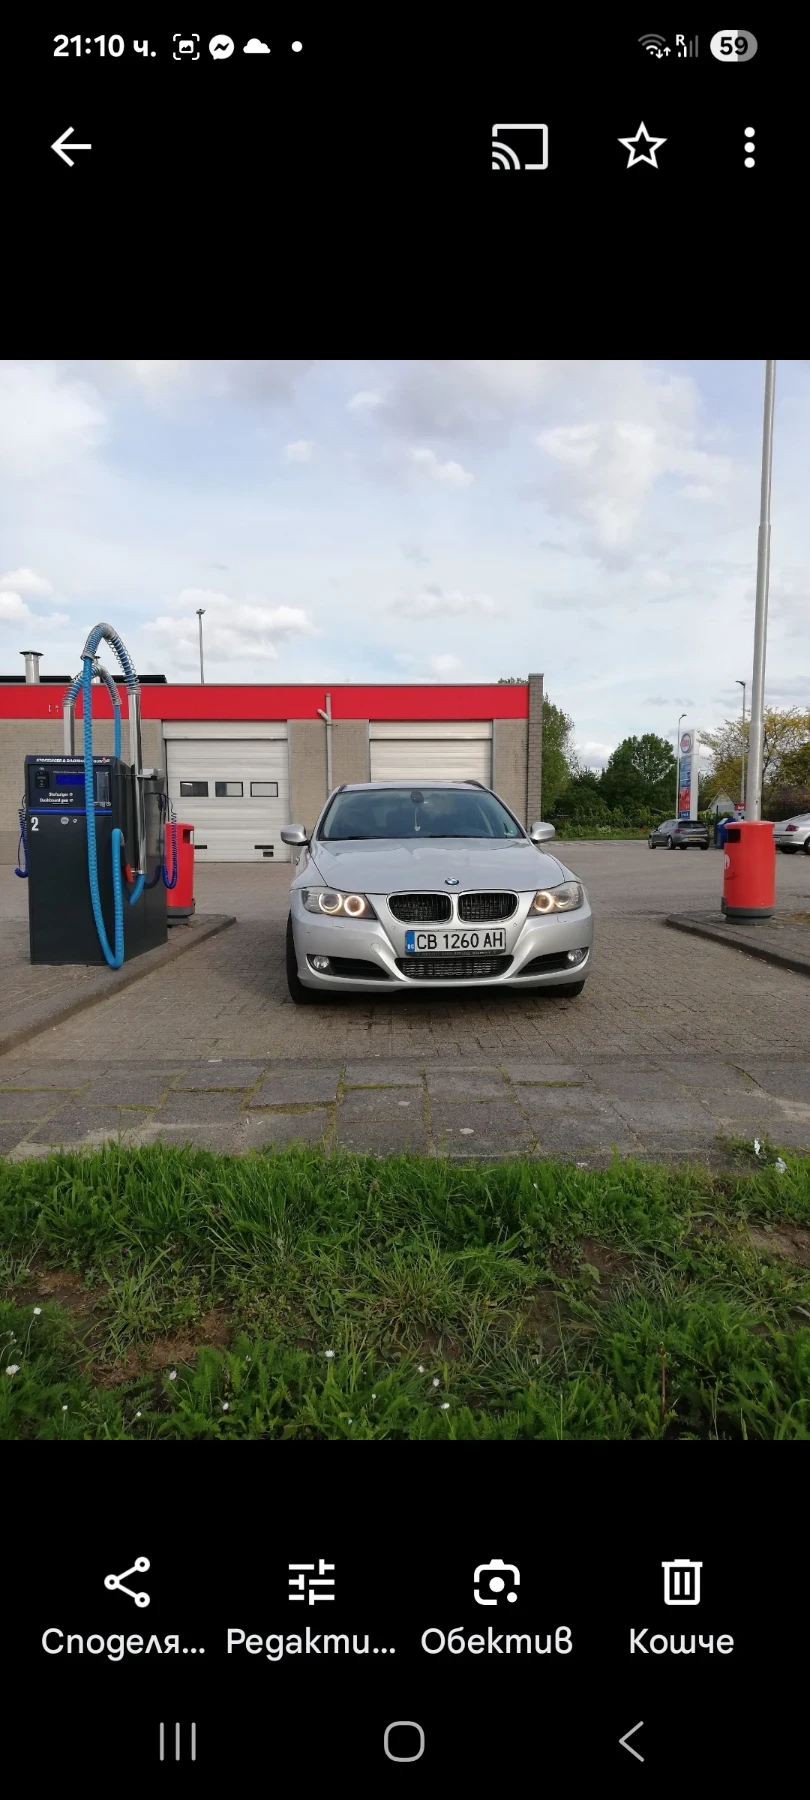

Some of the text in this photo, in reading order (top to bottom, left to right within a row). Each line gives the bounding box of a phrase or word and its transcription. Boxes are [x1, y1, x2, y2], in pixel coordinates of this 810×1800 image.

[30, 816, 39, 831] 2
[416, 931, 503, 950] CB 1260 AH
